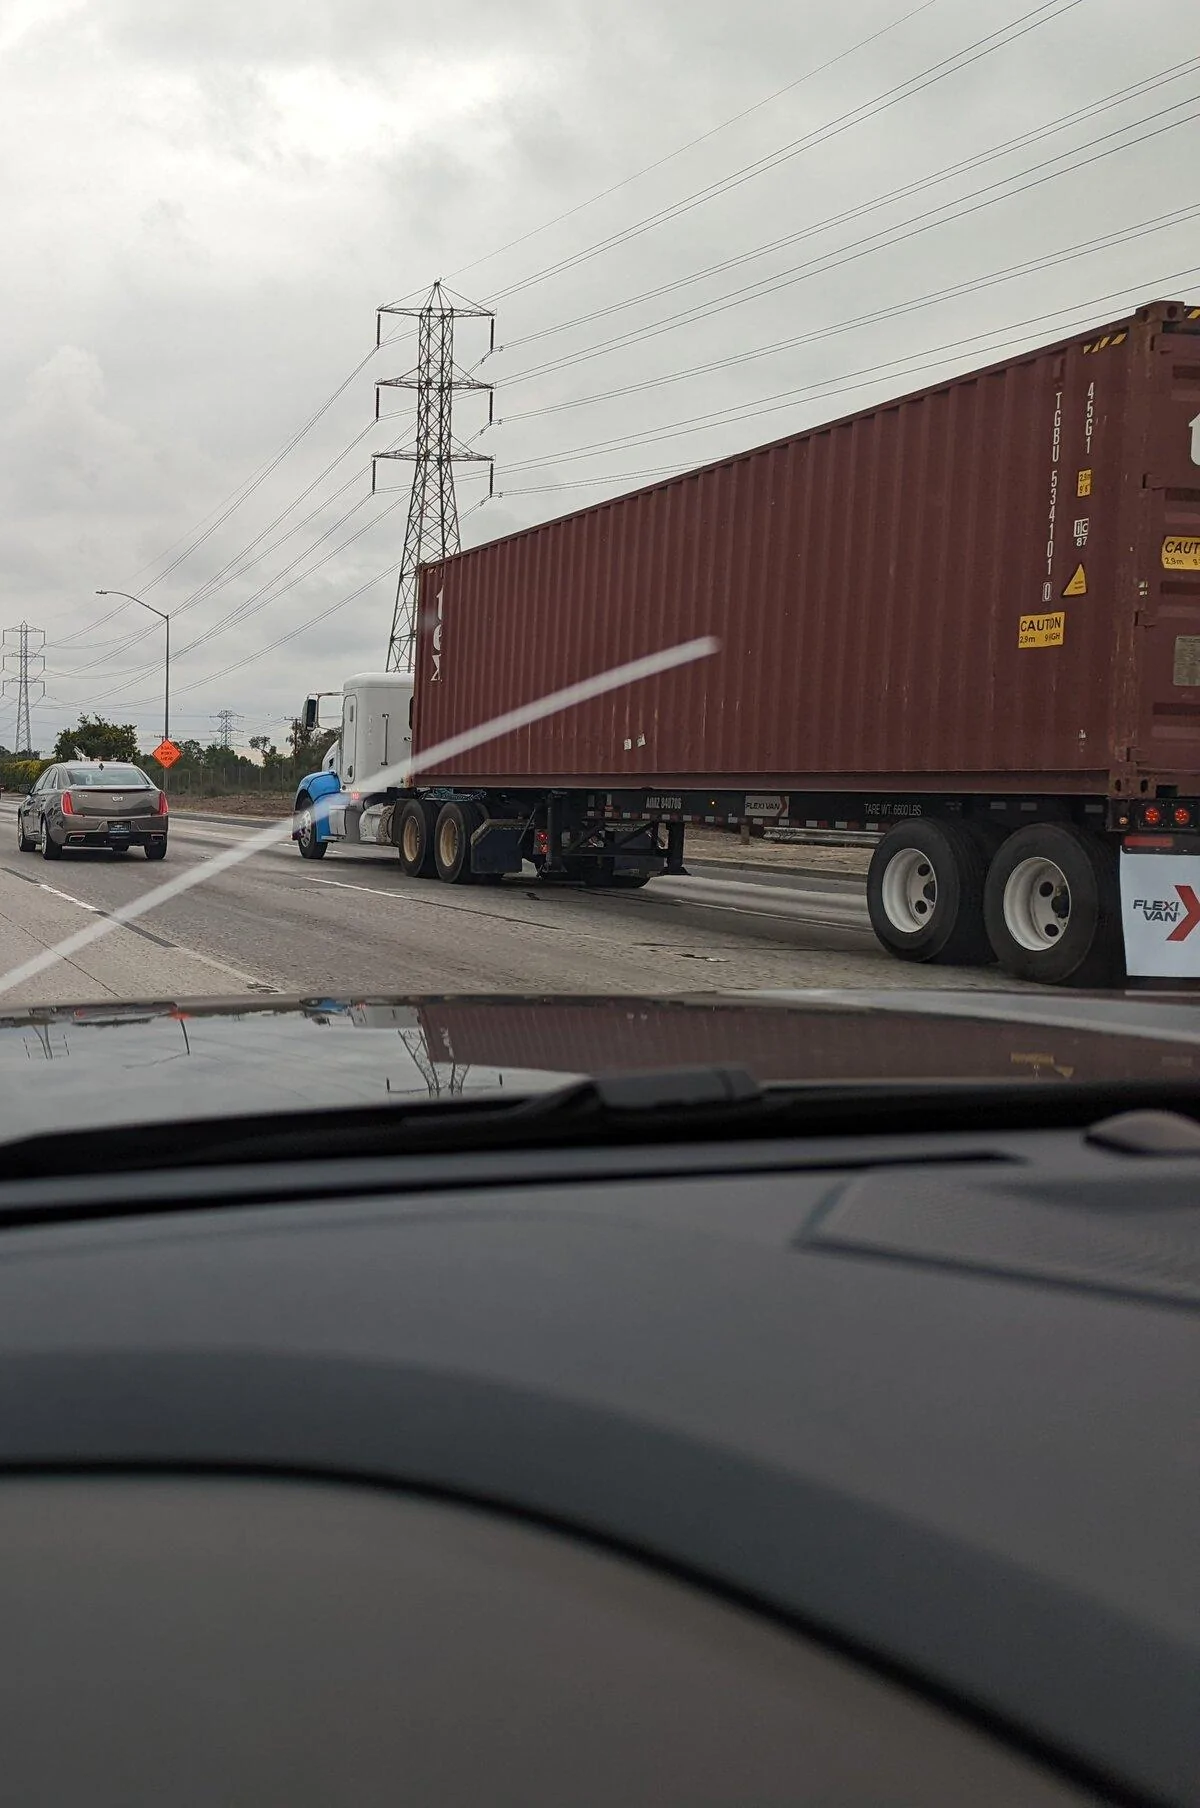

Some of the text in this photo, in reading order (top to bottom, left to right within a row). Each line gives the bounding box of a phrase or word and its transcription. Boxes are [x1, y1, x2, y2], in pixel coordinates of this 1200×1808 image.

[1085, 382, 1094, 454] 45G1
[1052, 392, 1062, 462] TGBU
[1047, 470, 1058, 575] 534101
[1076, 536, 1088, 547] 87
[765, 802, 781, 810] VAN
[1133, 899, 1179, 911] FLEXI
[1143, 910, 1177, 922] VAN
